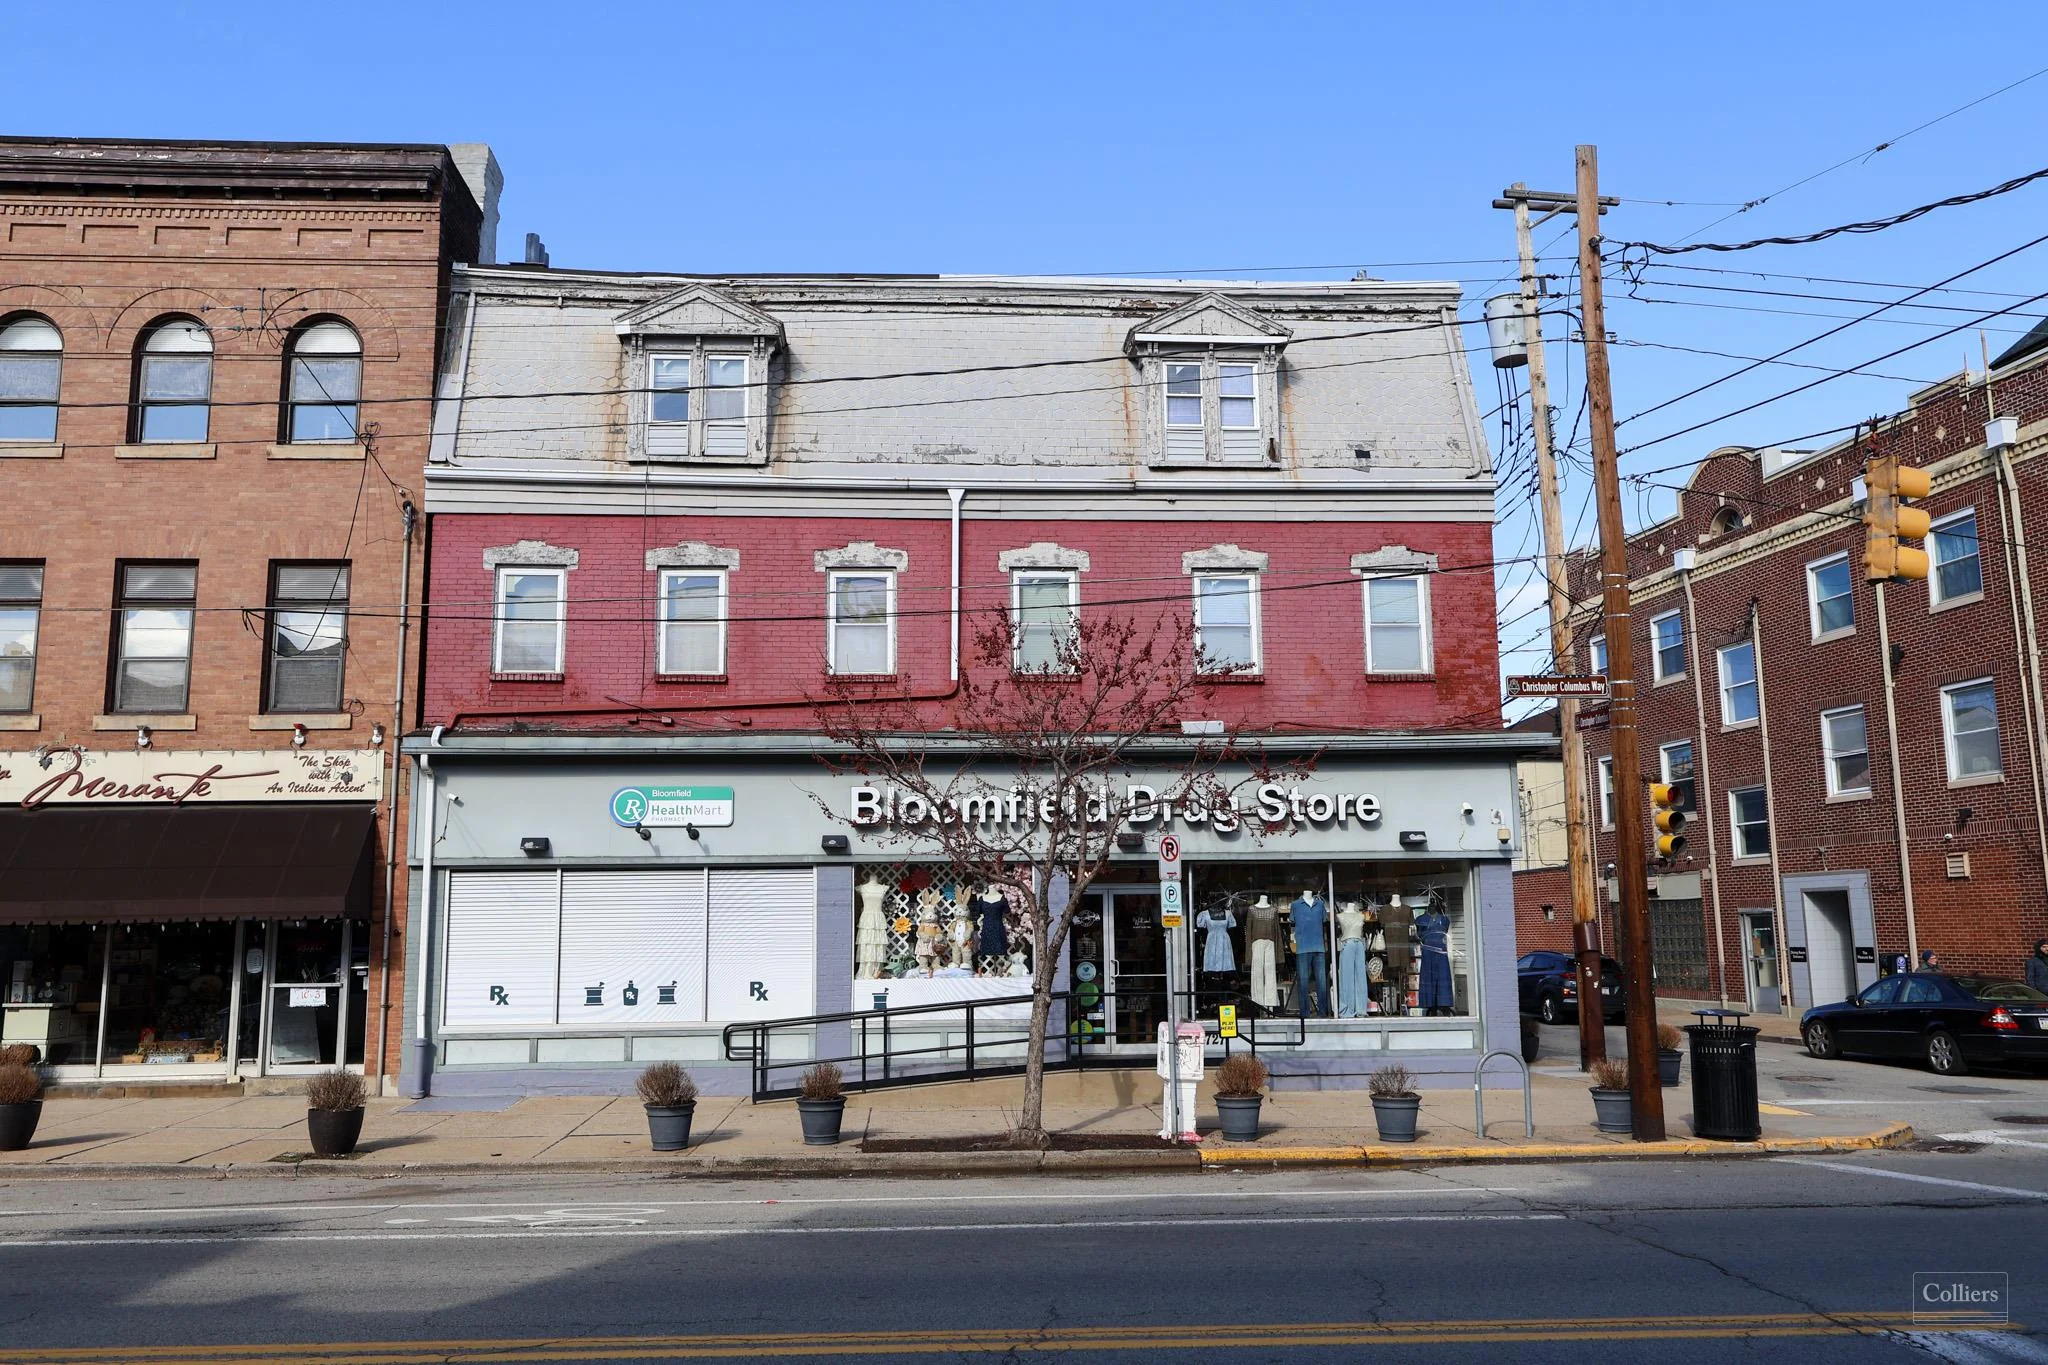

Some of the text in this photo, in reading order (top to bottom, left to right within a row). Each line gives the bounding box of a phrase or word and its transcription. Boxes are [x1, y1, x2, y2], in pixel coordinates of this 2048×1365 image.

[1522, 681, 1605, 694] Christopher Columbus Way
[322, 755, 351, 768] Shop
[308, 769, 331, 780] with
[265, 782, 283, 794] An
[287, 781, 325, 793] Italian
[652, 789, 692, 798] Bloomfield
[852, 784, 1381, 832] Bloomfield Drug Store
